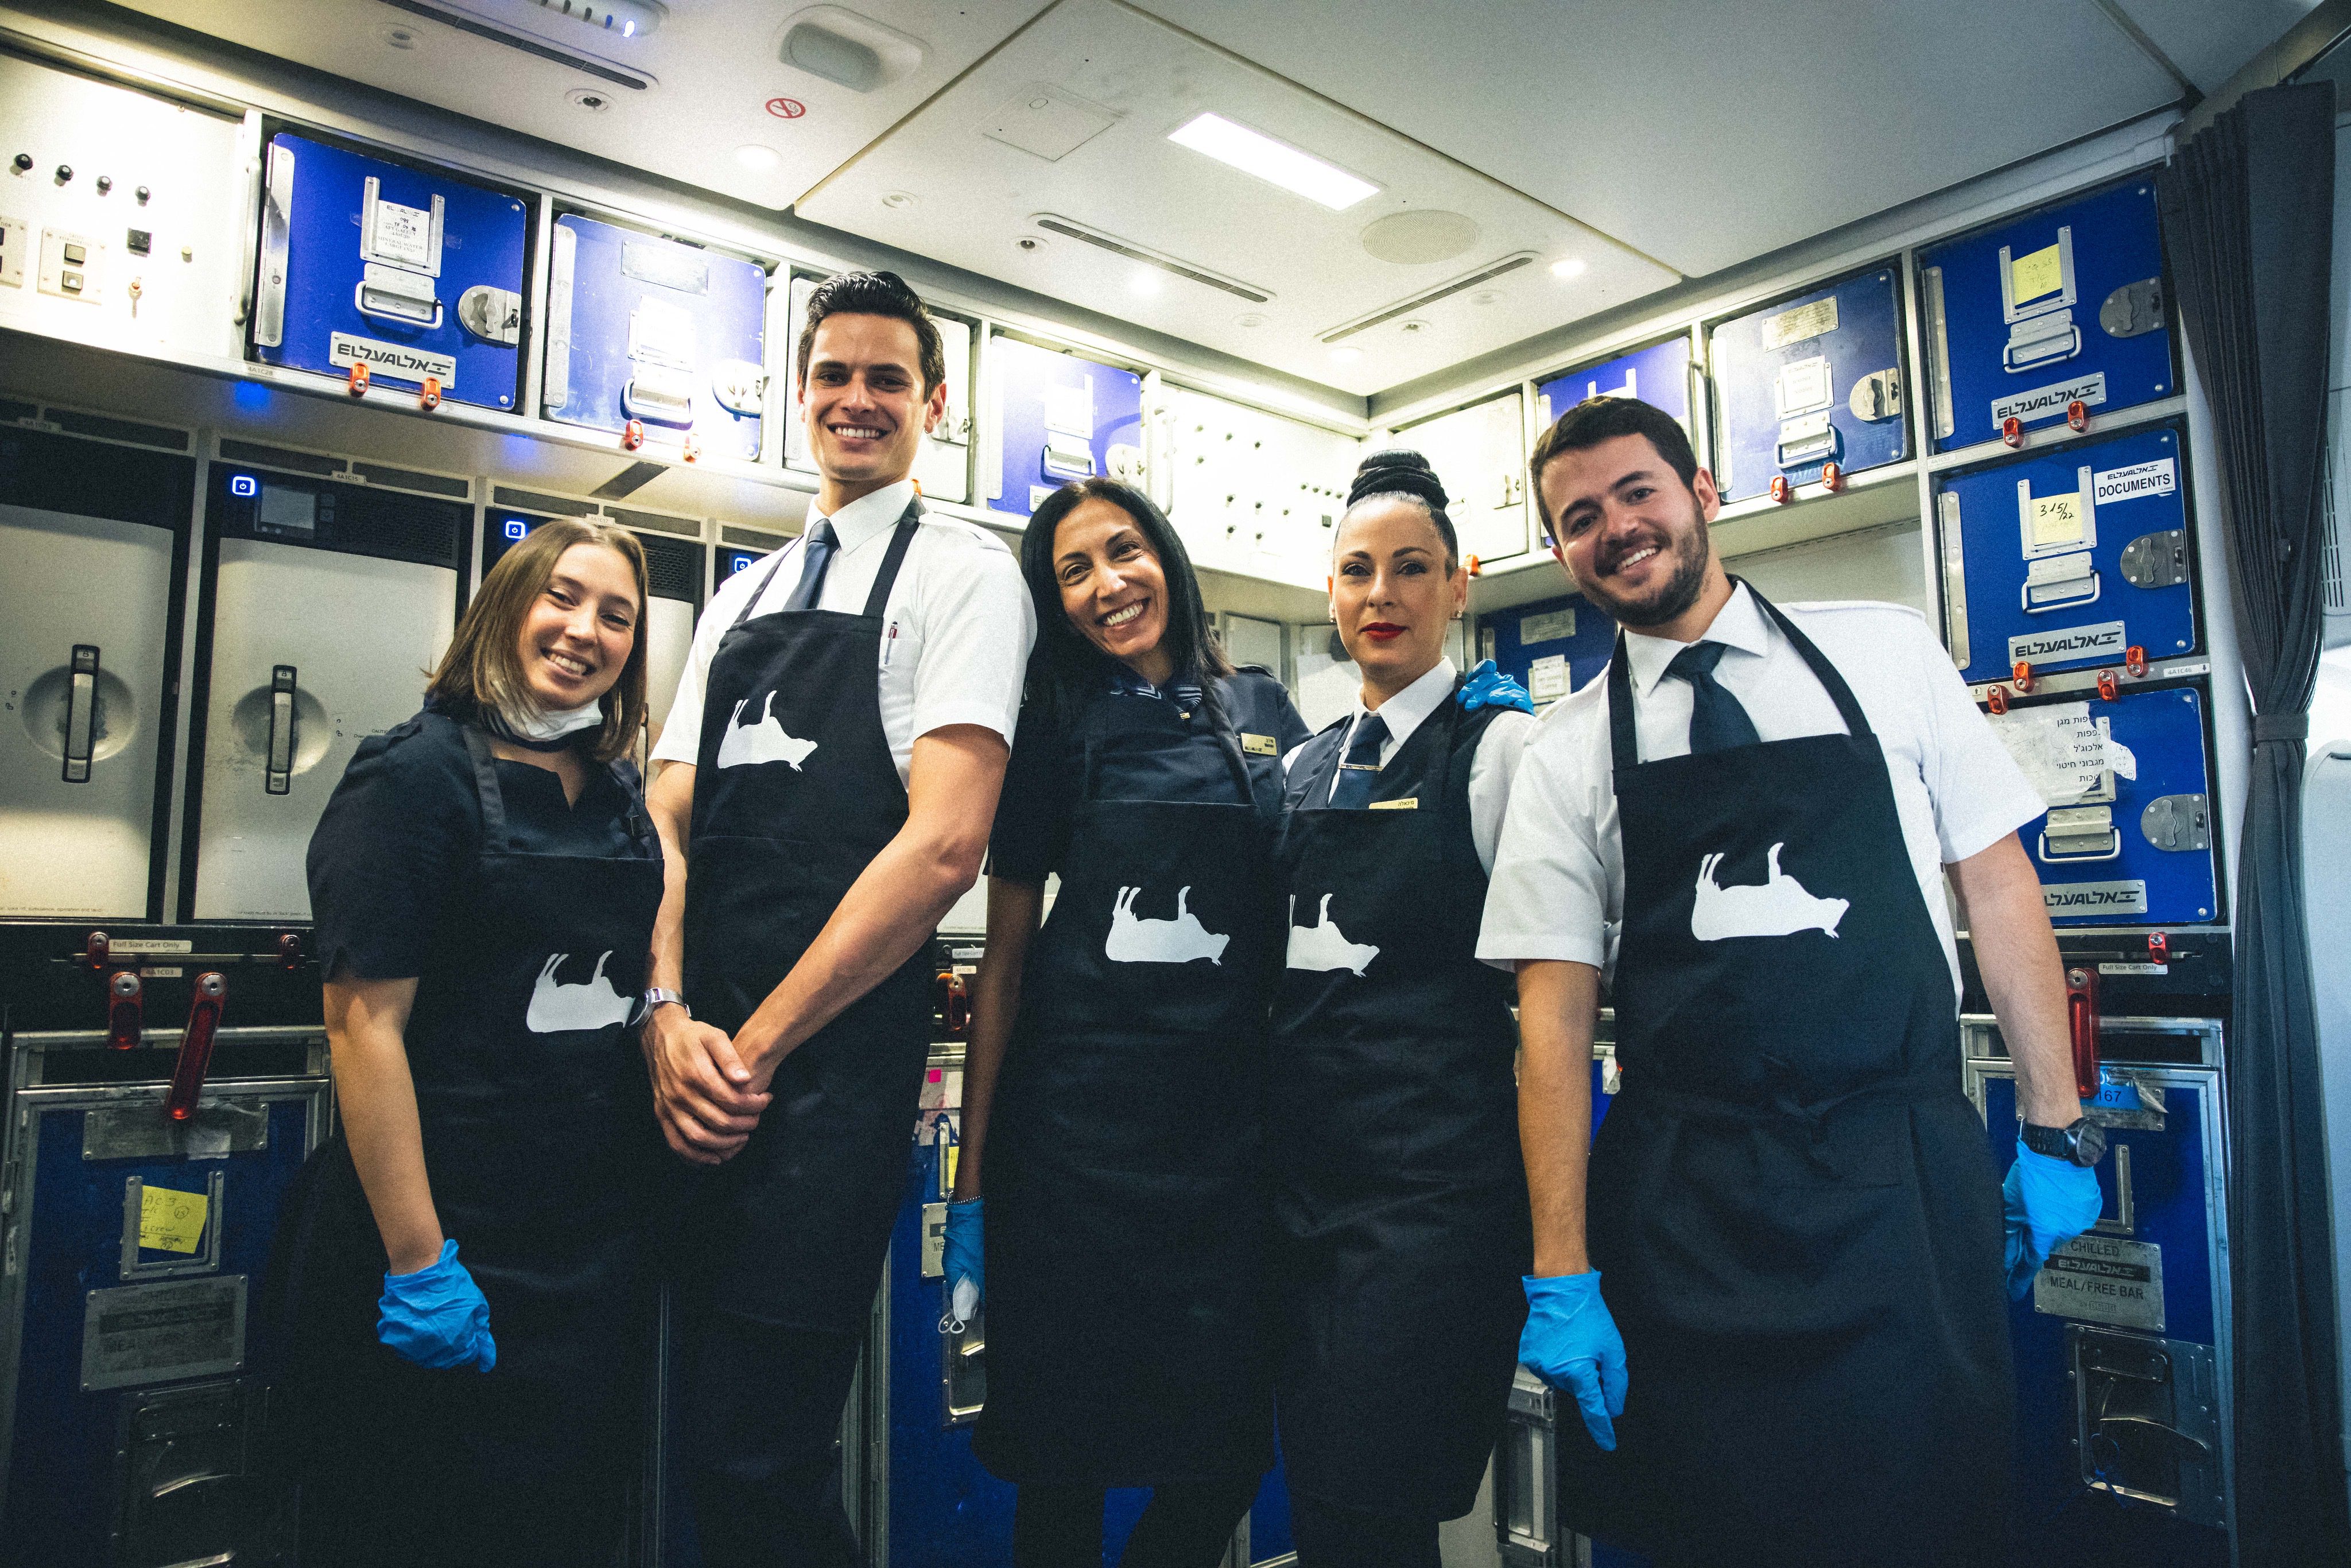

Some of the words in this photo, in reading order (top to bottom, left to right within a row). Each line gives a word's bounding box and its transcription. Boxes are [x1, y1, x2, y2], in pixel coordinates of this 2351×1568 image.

[2098, 473, 2171, 498] DOCUMENTS
[2168, 667, 2192, 675] 4A1C46
[2057, 718, 2070, 728] מגן
[2073, 716, 2090, 724] פות
[2076, 729, 2101, 738] פפות
[2057, 761, 2076, 769] חיטוי
[2079, 758, 2104, 767] מגבוני
[2070, 1240, 2121, 1257] CHILLED
[2050, 1276, 2117, 1297] MEAL/FREE
[2119, 1286, 2144, 1300] BAR
